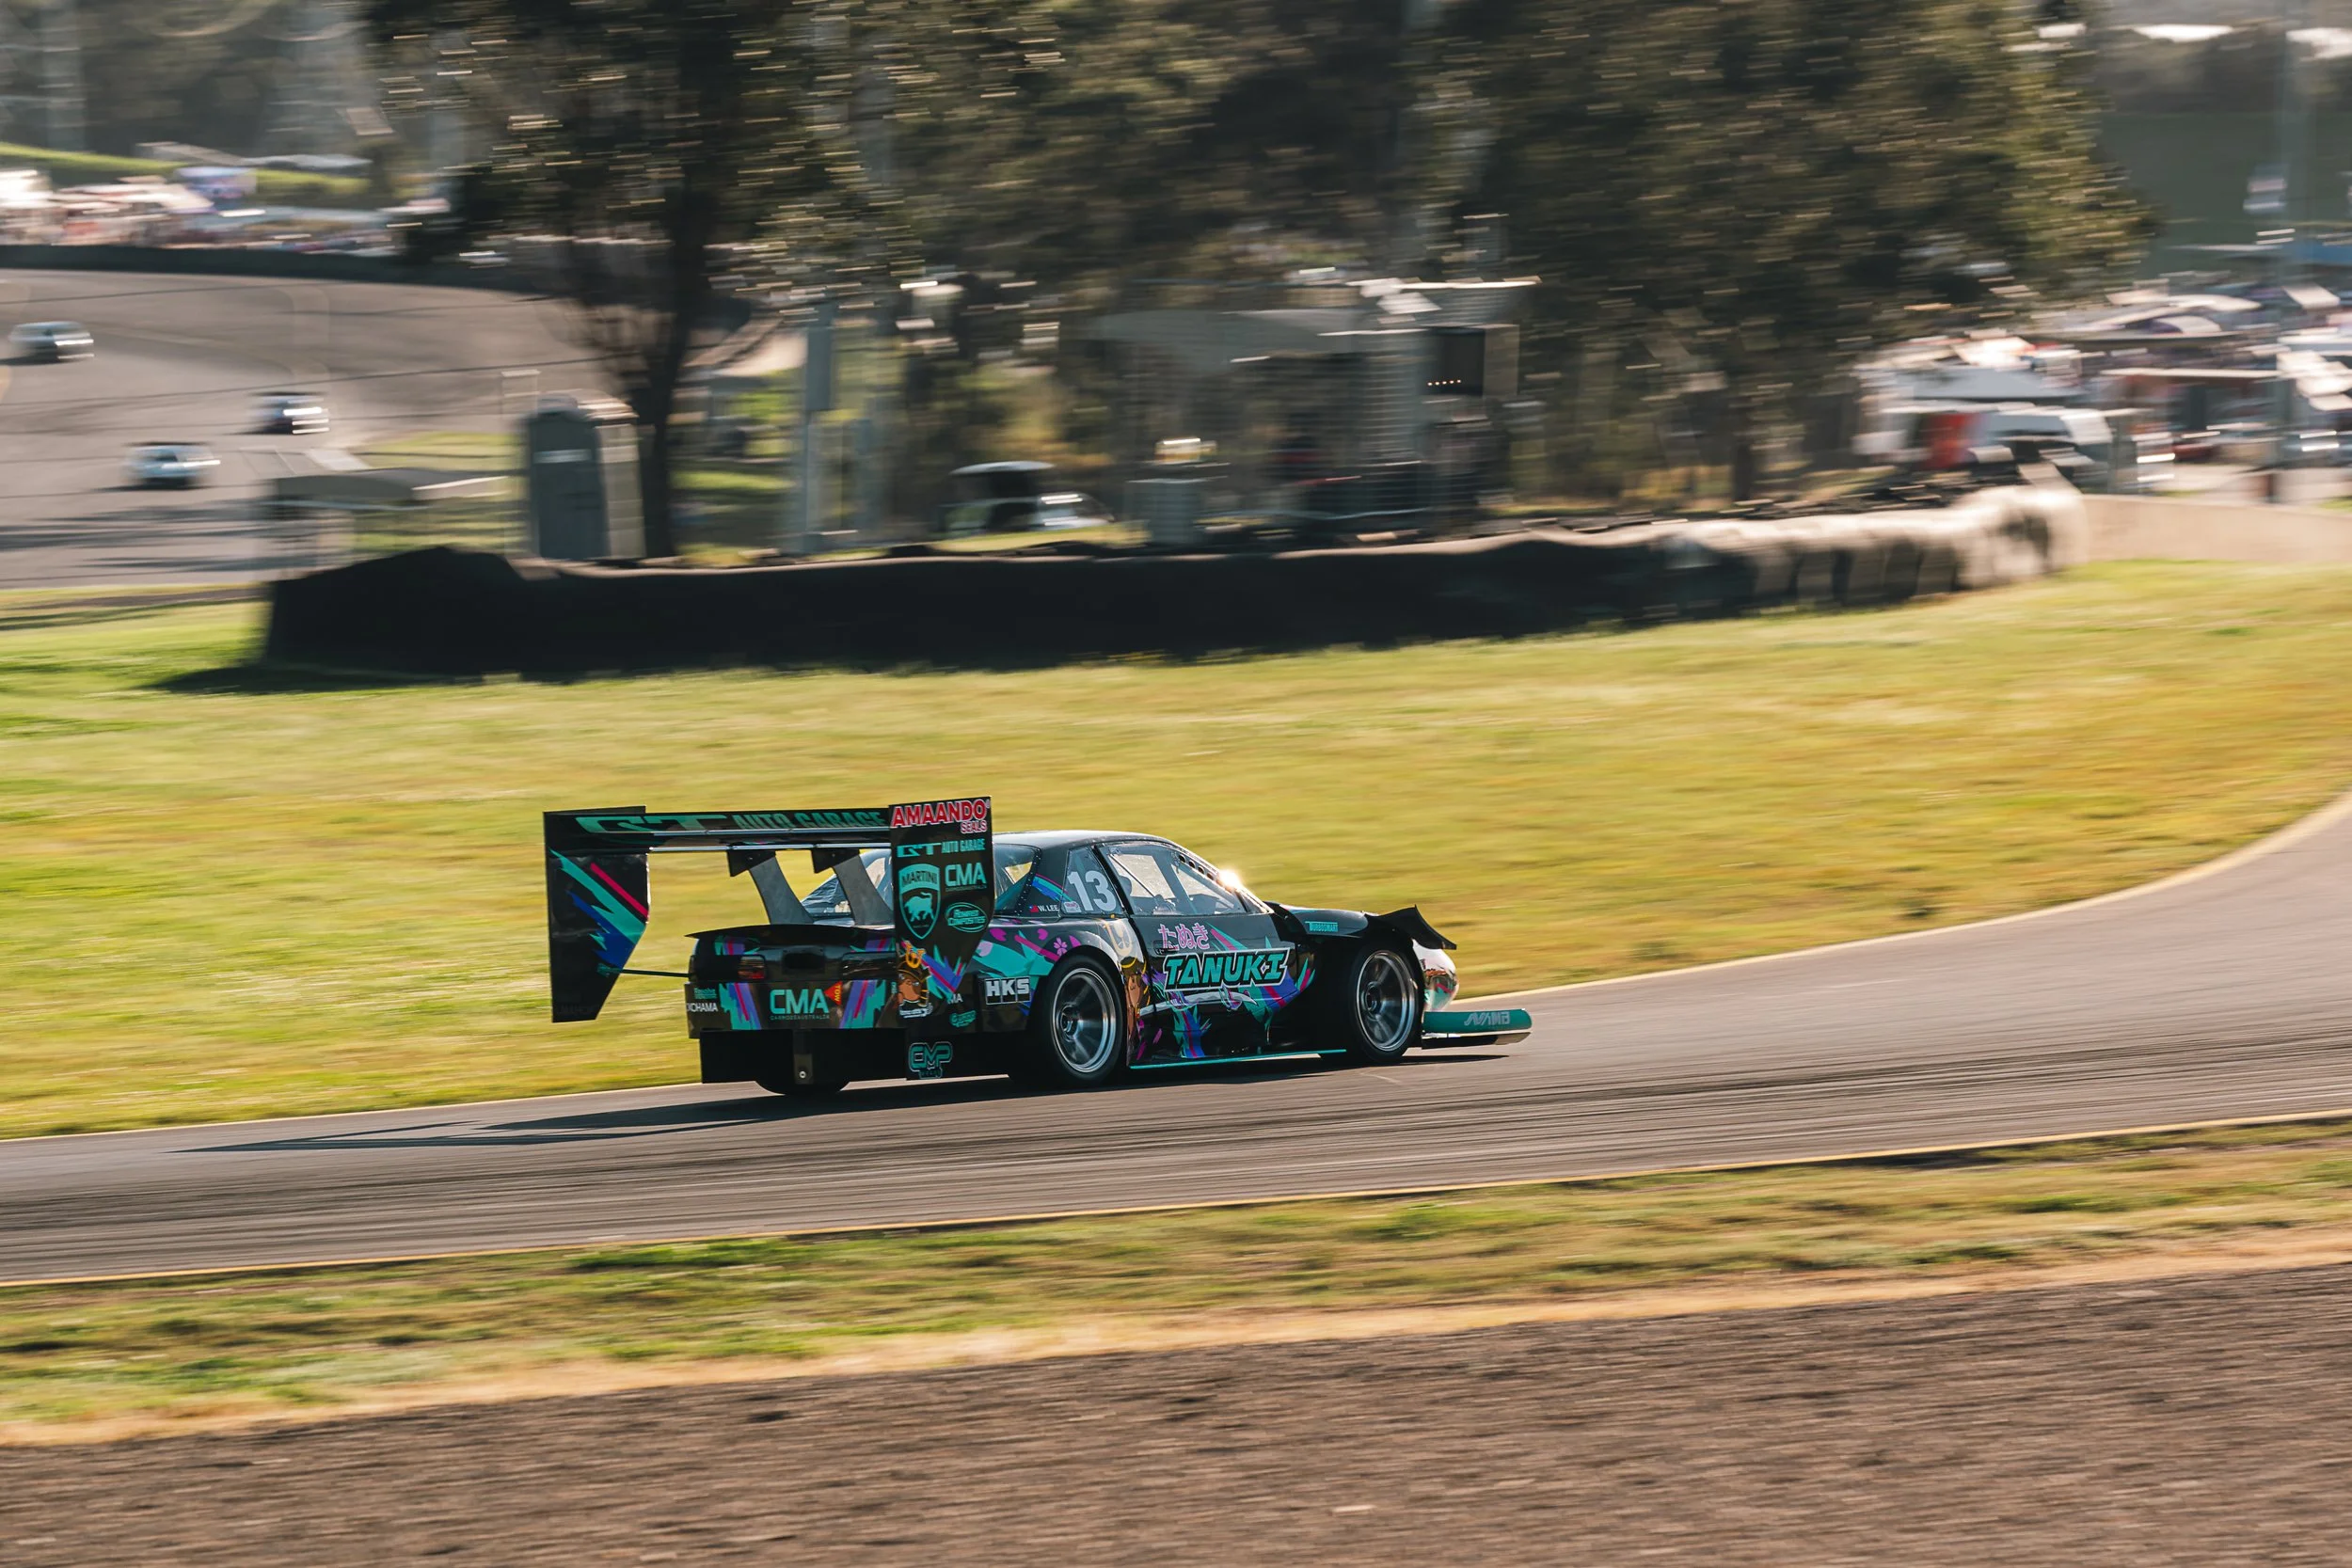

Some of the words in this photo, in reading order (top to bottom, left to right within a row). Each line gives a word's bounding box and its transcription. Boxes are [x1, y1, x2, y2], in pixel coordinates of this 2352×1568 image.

[732, 814, 795, 830] AUTO
[794, 812, 886, 829] GARAGE
[891, 799, 987, 828] AMAANDO
[961, 819, 988, 834] SEALS
[897, 843, 942, 858] GT
[942, 841, 959, 853] AUTO
[960, 838, 986, 852] GARAGE
[945, 862, 987, 887] CMA
[1067, 870, 1117, 911] 13
[1158, 922, 1211, 951] たぬき
[1164, 951, 1287, 989] TANUKI
[985, 978, 1030, 998] HKS
[770, 989, 830, 1015] CMA
